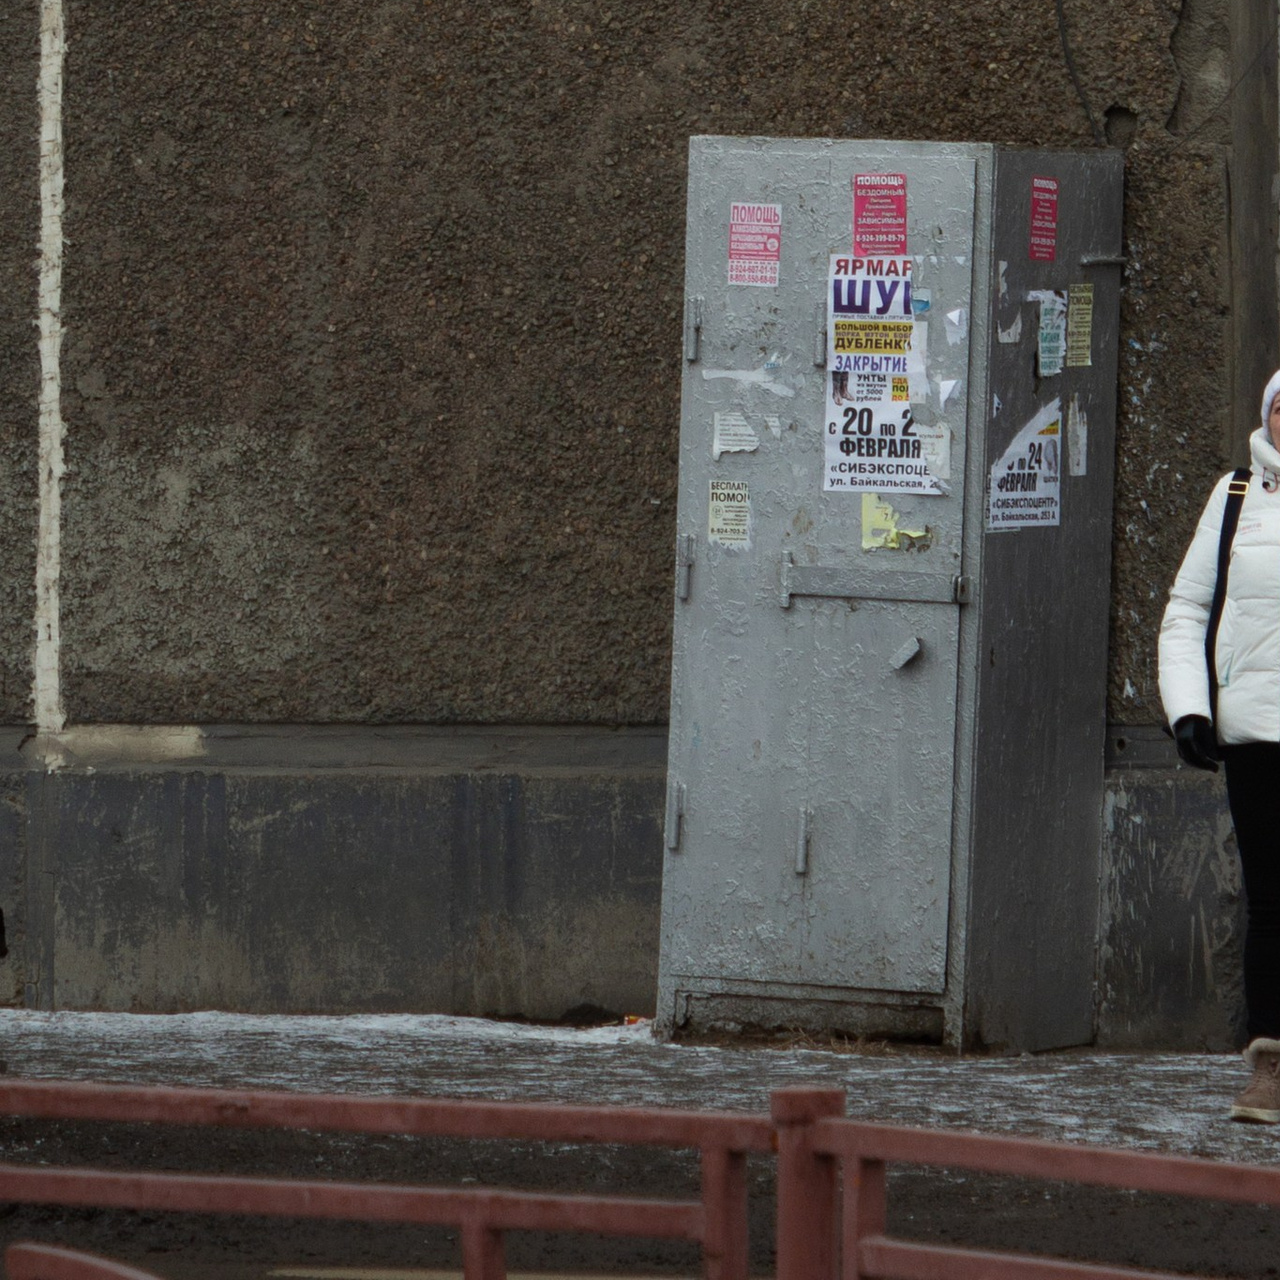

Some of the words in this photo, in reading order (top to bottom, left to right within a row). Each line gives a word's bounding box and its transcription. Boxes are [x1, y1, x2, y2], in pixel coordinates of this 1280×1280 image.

[857, 176, 904, 186] ПОМОЩЬ
[732, 205, 780, 224] ПОМОЩЬ
[835, 323, 880, 331] БОЛЬШОЙ
[857, 374, 886, 382] УНТЫ
[842, 407, 873, 436] 20
[840, 437, 921, 459] ФЕВРАЛЯ
[1028, 442, 1042, 470] 24
[830, 478, 846, 487] ул.
[850, 477, 926, 489] Байкальская,
[998, 472, 1037, 492] ФЕВРАЛЯ
